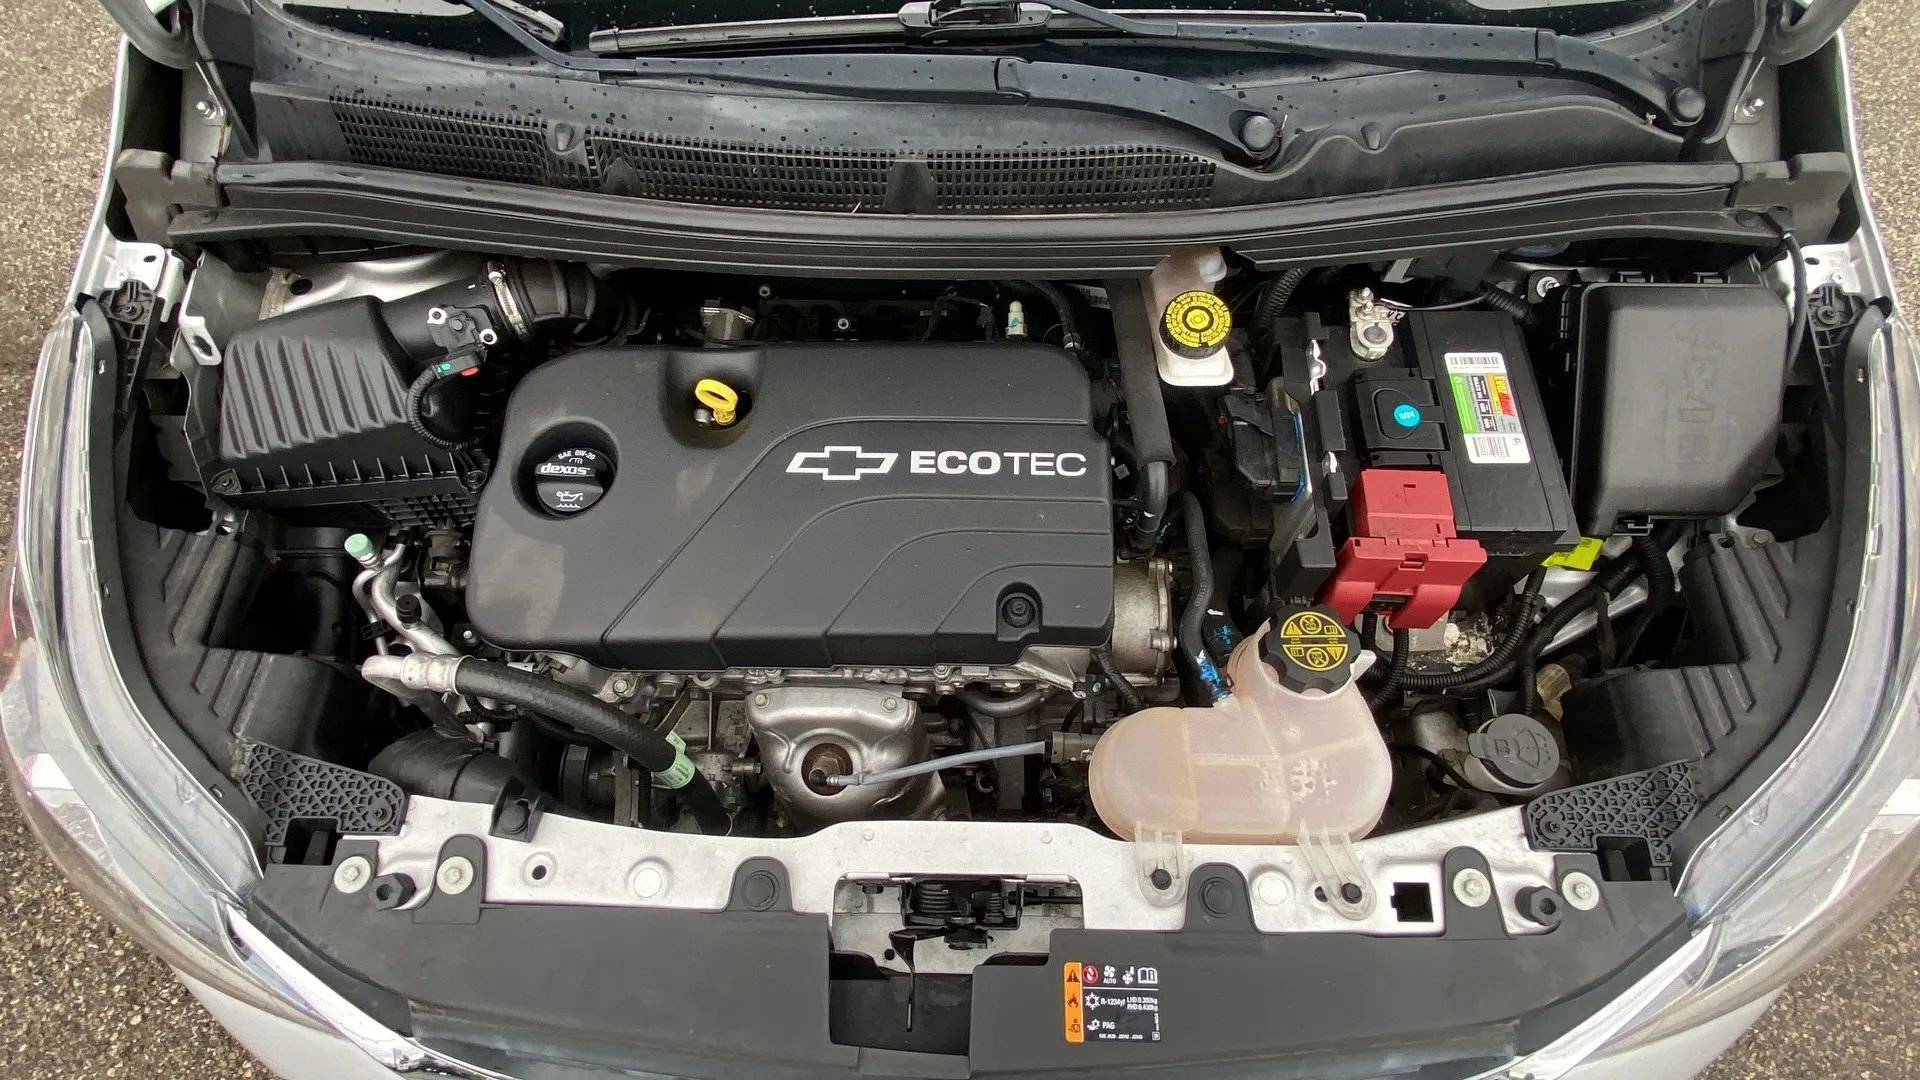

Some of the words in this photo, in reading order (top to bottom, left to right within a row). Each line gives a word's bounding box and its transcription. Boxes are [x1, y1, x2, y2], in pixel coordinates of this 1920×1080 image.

[558, 450, 573, 460] SAE
[910, 450, 1087, 477] ECOTEC
[1102, 1021, 1115, 1029] PAG
